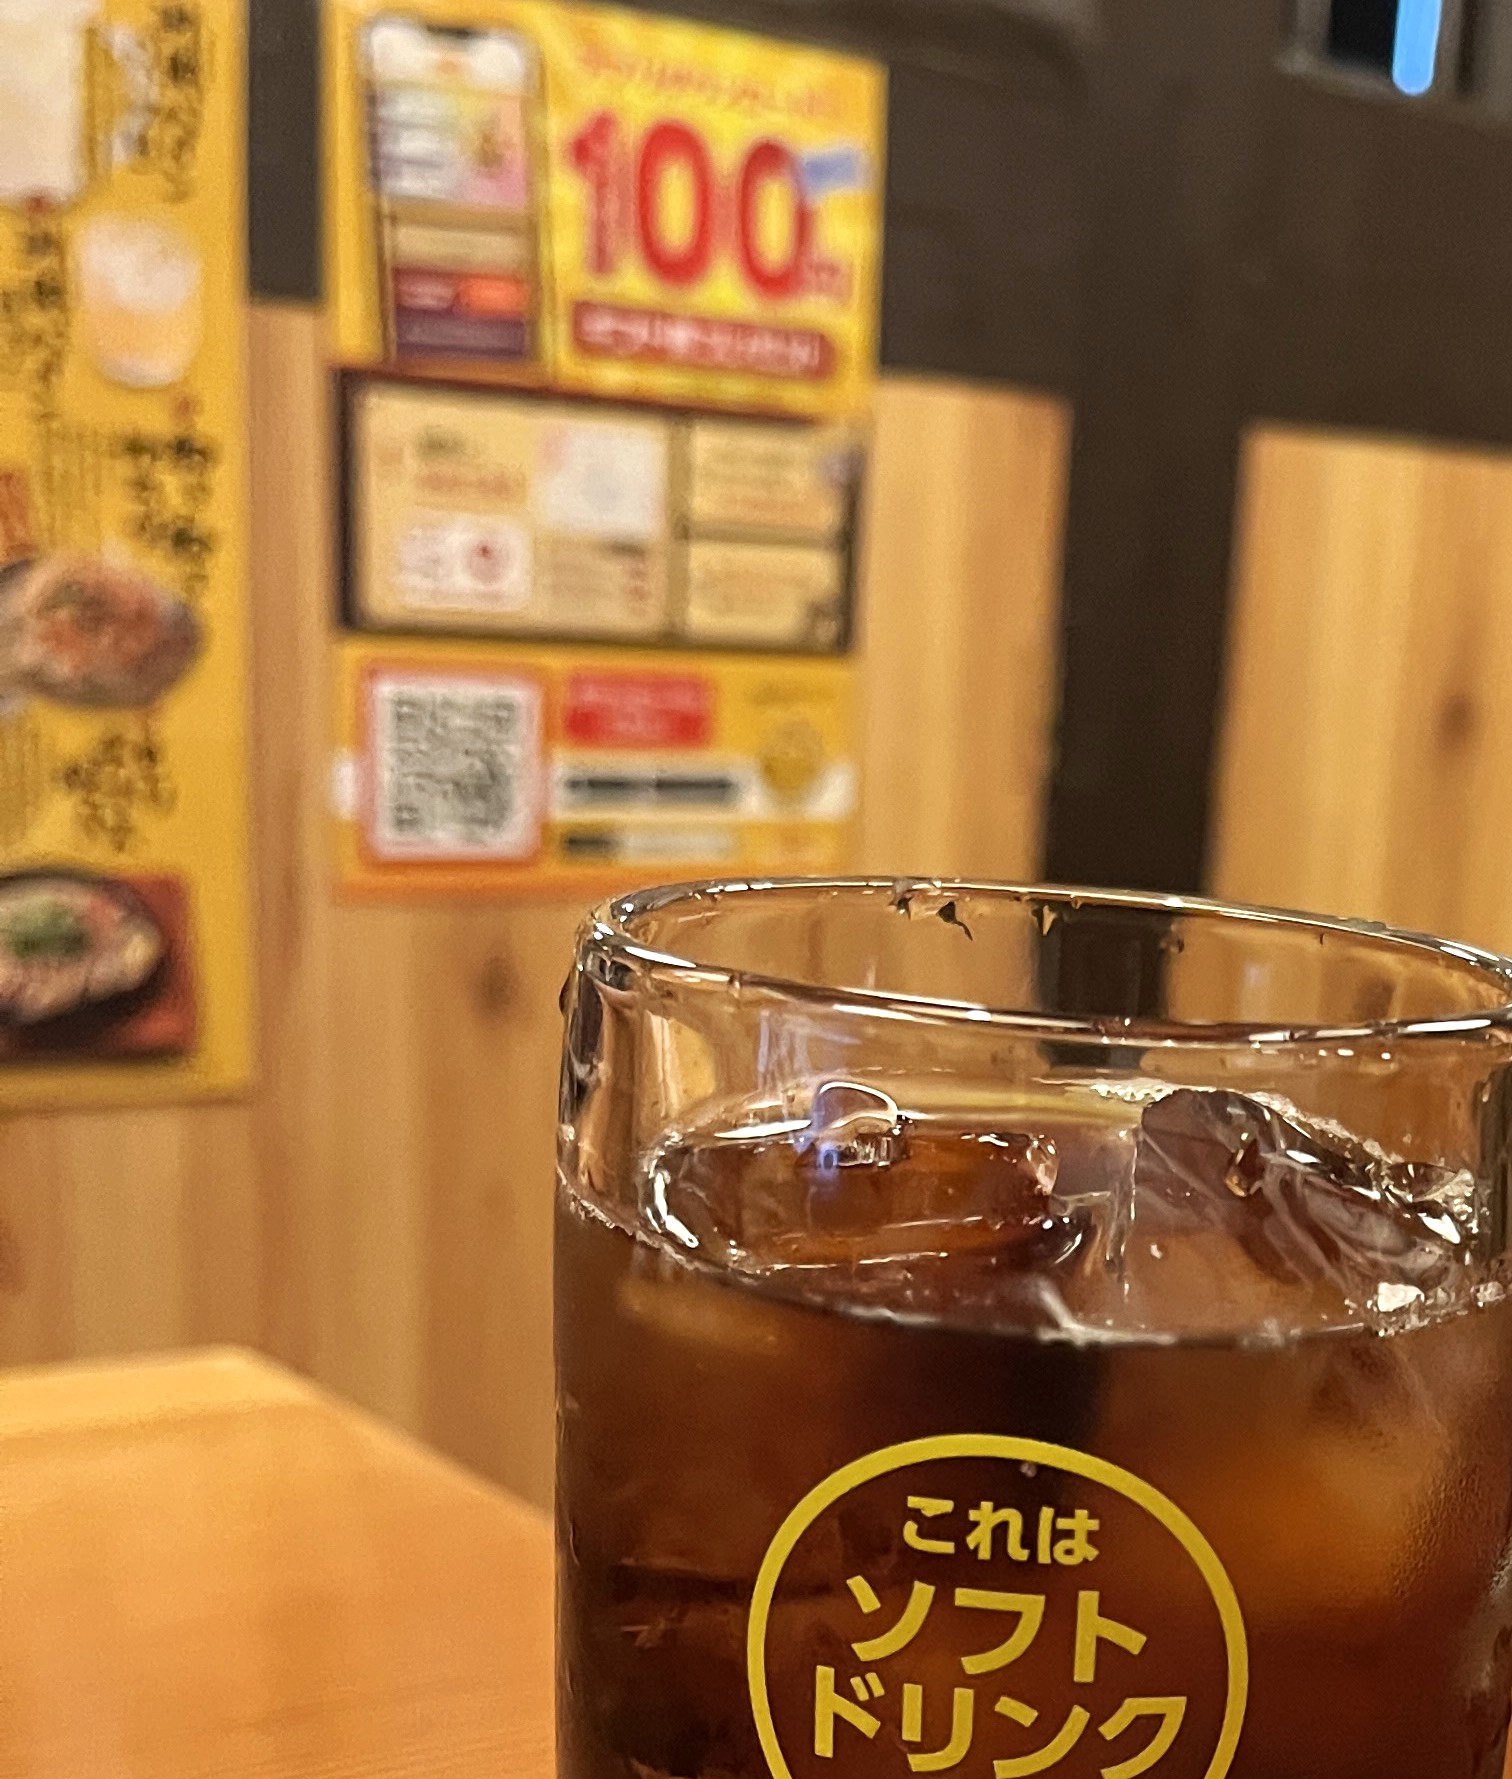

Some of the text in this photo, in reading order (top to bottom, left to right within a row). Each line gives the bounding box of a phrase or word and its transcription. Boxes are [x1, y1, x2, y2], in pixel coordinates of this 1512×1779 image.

[903, 1495, 1099, 1566] これは
[846, 1575, 1147, 1683] ソフト
